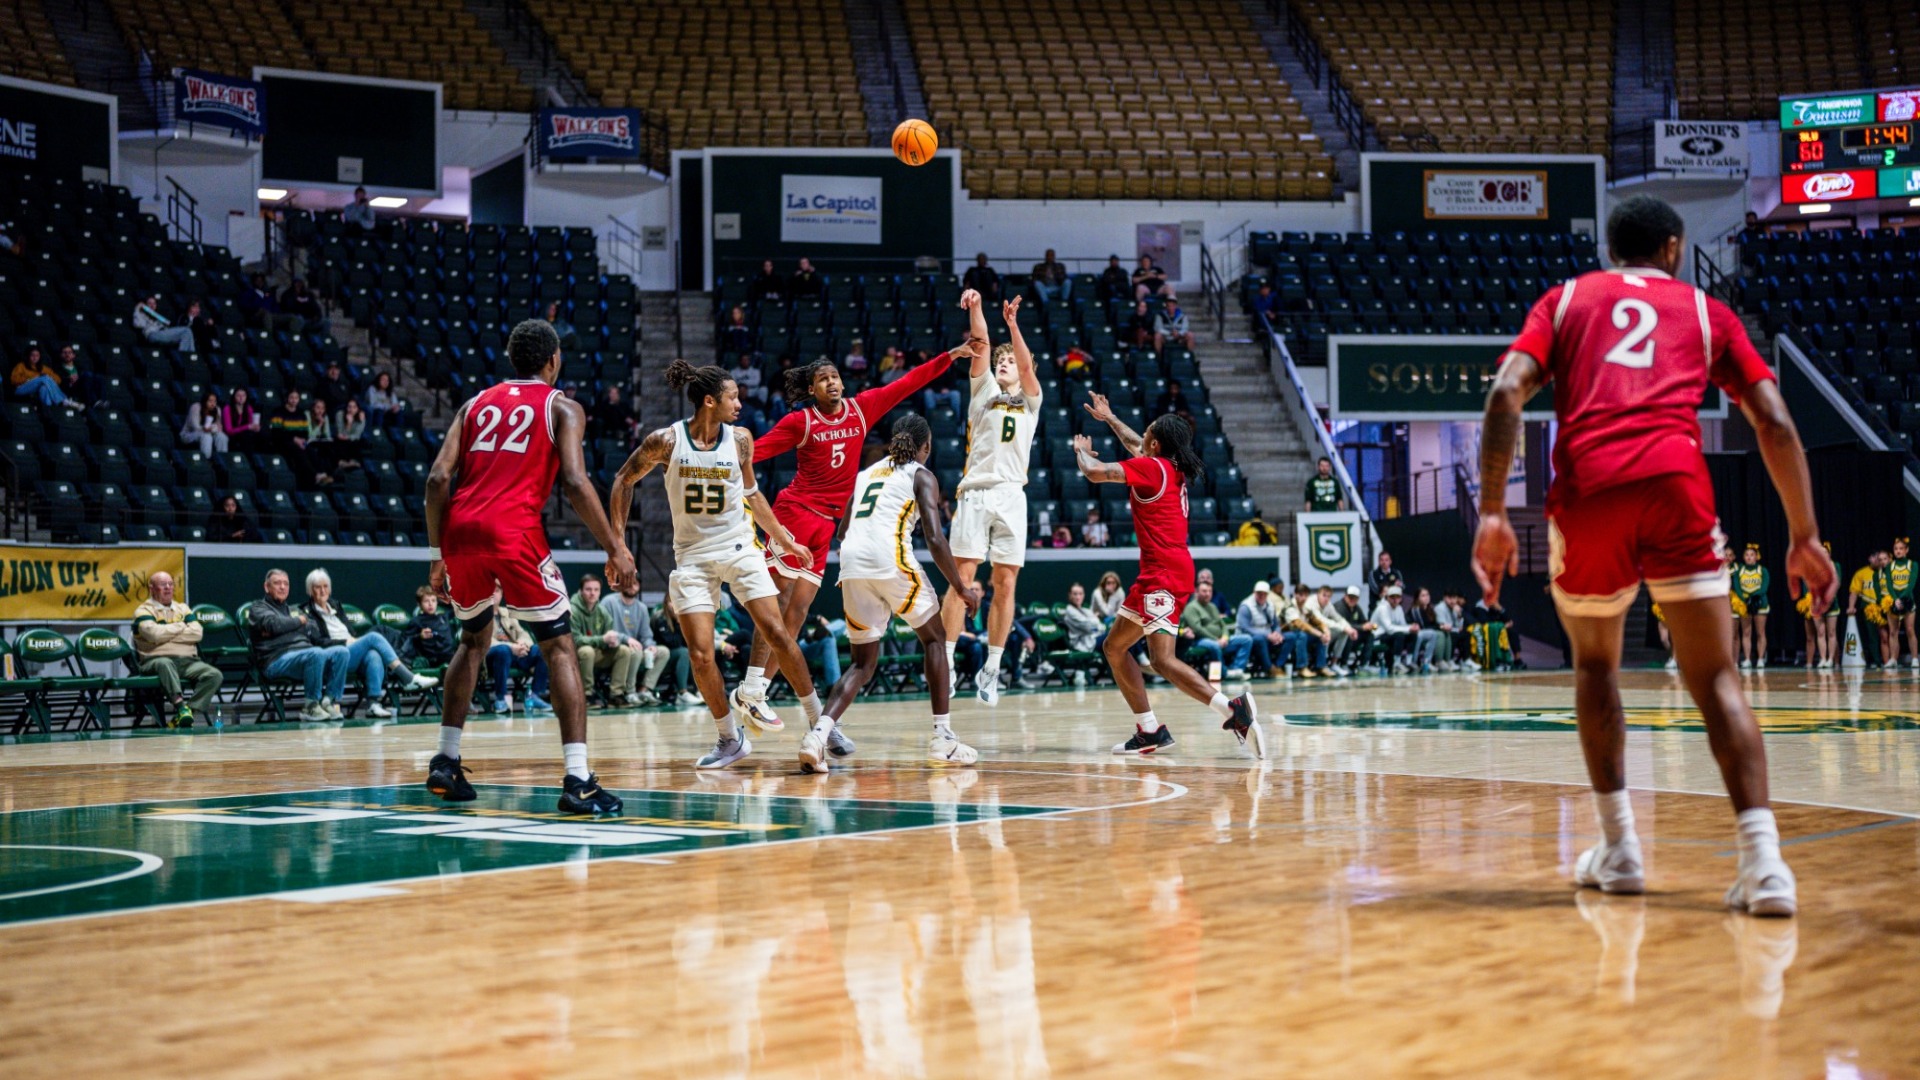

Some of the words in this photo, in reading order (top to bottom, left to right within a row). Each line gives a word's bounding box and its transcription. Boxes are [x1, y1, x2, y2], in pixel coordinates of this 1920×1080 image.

[0, 117, 37, 148] NE
[1664, 123, 1740, 139] RONNIE'S
[1865, 124, 1908, 147] 1:44
[1800, 141, 1824, 162] 60
[1884, 149, 1896, 165] 2
[787, 193, 808, 209] La
[812, 194, 877, 214] Capitol
[1604, 298, 1658, 368] 2
[469, 404, 535, 454] 22
[812, 426, 860, 443] NICHOLLS
[831, 442, 846, 469] 5
[684, 484, 725, 515] 23
[855, 482, 885, 519] 5
[1318, 533, 1342, 562] S
[0, 558, 55, 598] LION
[57, 560, 99, 588] UP!
[64, 588, 108, 608] with
